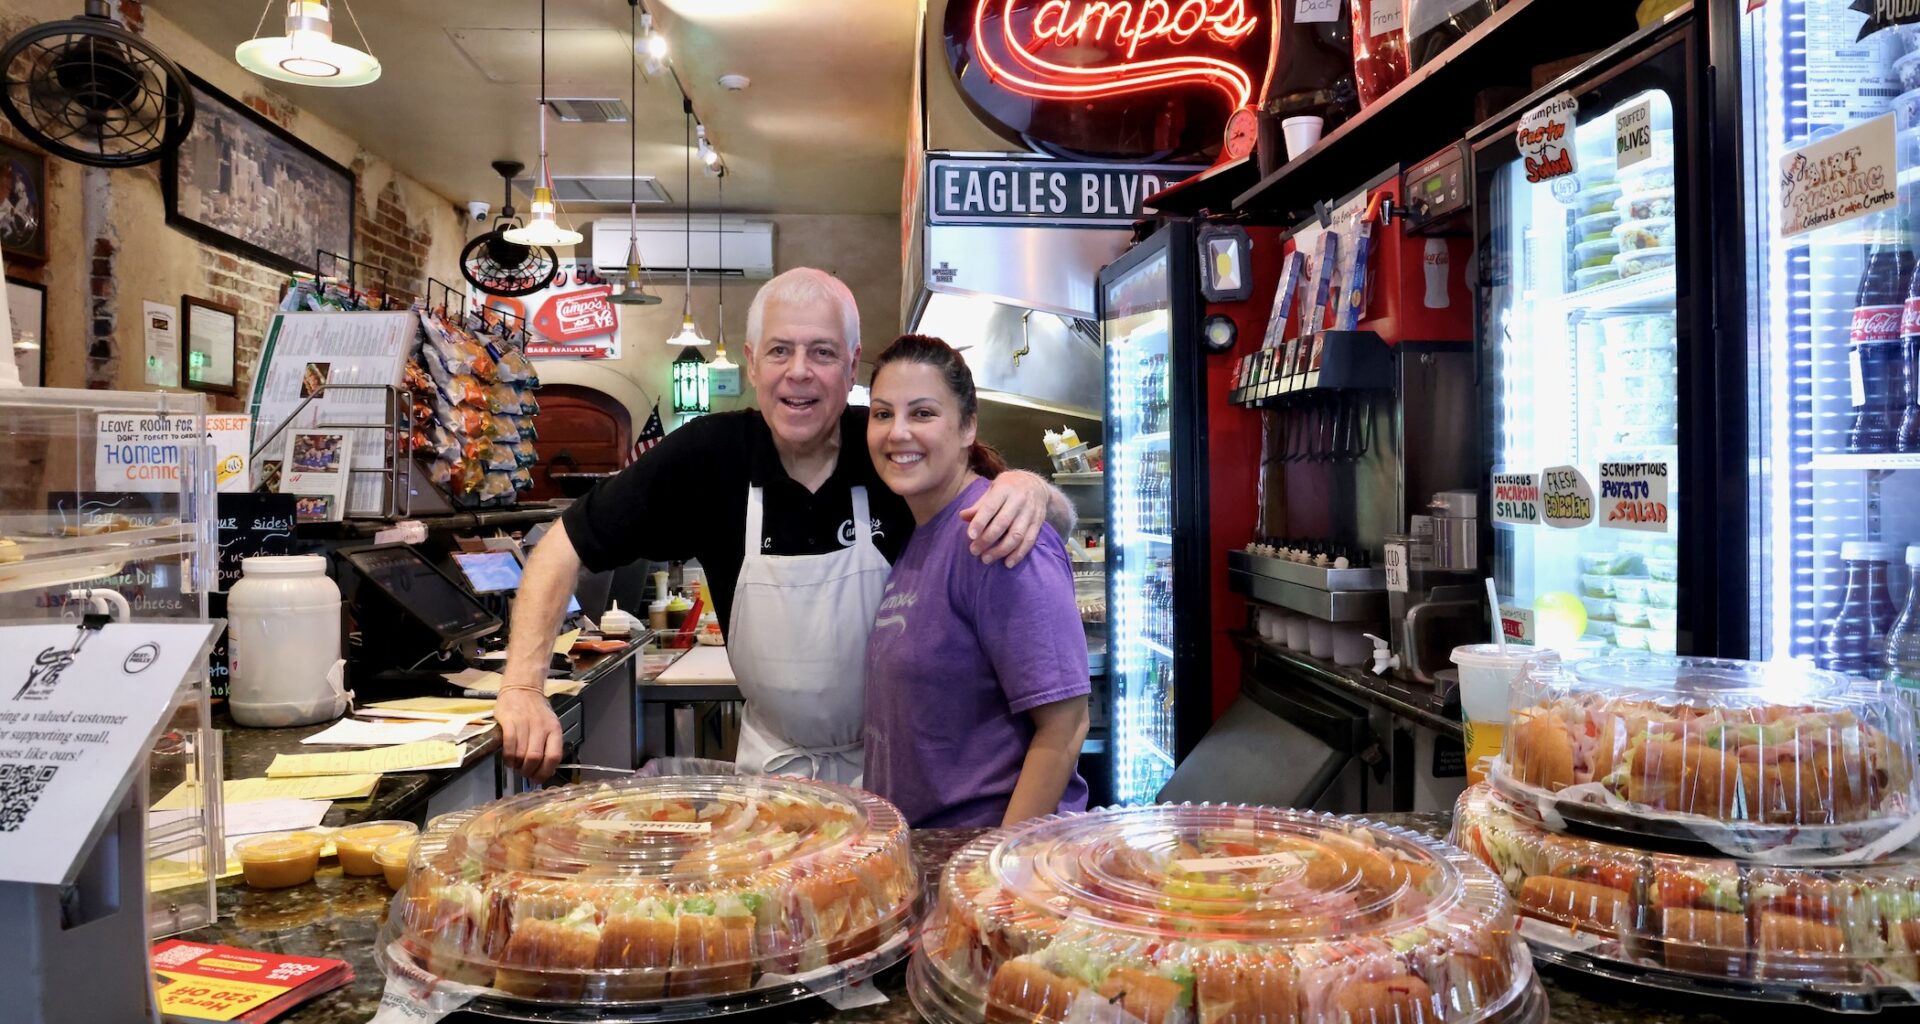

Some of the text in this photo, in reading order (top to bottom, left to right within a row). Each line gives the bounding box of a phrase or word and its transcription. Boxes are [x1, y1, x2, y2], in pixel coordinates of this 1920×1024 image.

[1617, 108, 1646, 131] STUFFED
[1617, 125, 1650, 154] OLIVES
[945, 170, 1067, 213] EAGLES
[1863, 189, 1895, 208] Crumbs
[206, 418, 248, 430] ESSERT
[1601, 463, 1667, 477] SCRUMPTIOUS
[1494, 475, 1531, 486] DELICIOUS
[1547, 471, 1578, 491] FRESH
[1495, 486, 1538, 501] MACARONI
[1496, 502, 1536, 520] SALAD
[21, 713, 30, 721] a
[33, 710, 73, 722] valued
[72, 713, 128, 724] customer
[11, 729, 72, 745] supporting
[73, 731, 110, 744] small,
[24, 747, 48, 760] like
[49, 749, 84, 761] ours!
[278, 962, 321, 971] FOOD
[164, 995, 231, 1011] Here's
[210, 991, 258, 1003] $20
